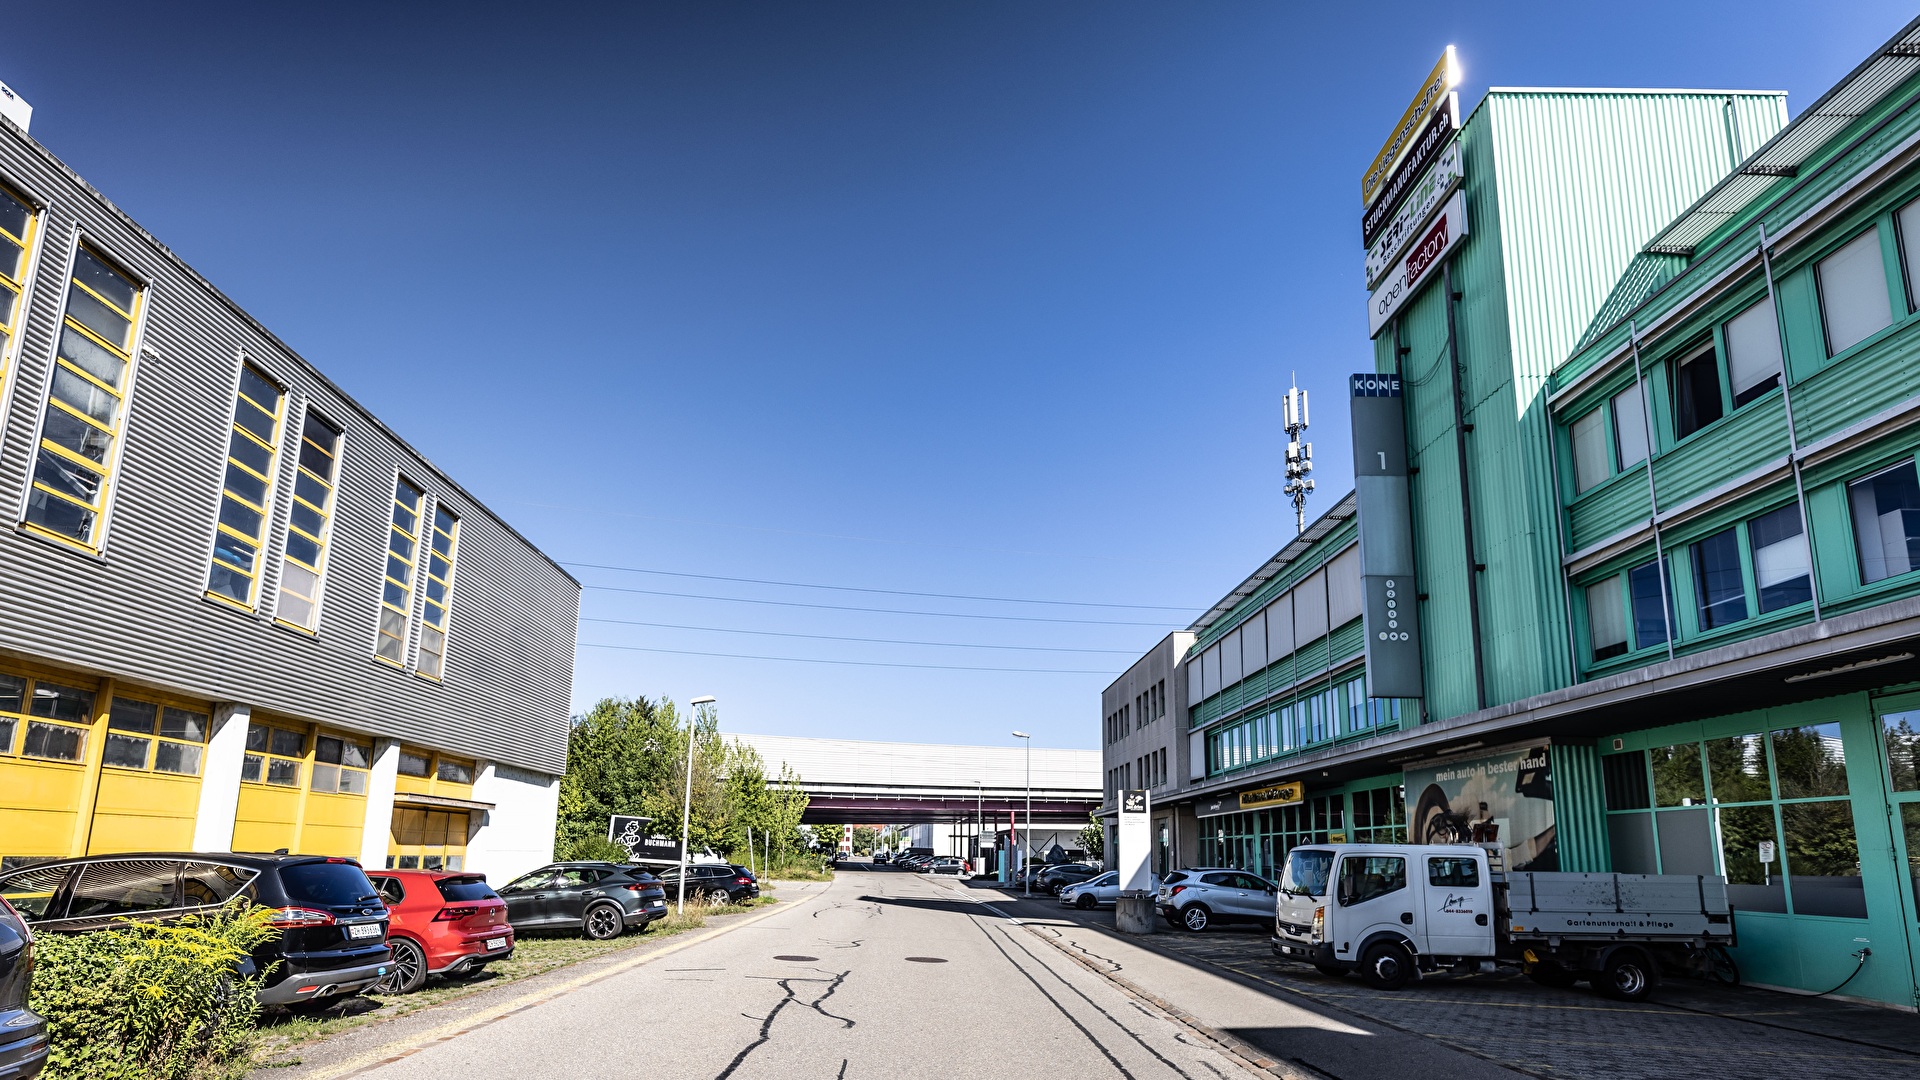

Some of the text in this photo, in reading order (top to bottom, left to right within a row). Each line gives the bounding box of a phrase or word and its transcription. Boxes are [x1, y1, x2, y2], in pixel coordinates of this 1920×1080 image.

[1364, 112, 1449, 236] STUCKMANUFAKTUR.ch
[1364, 172, 1379, 194] Die
[1382, 195, 1436, 265] Beschriftungen
[1354, 380, 1400, 391] KONE
[1377, 451, 1386, 470] 1
[1435, 753, 1547, 782] mein auto in bester hand
[645, 839, 676, 848] BUCHMANN
[1566, 919, 1637, 927] Gartenunterhalt
[1646, 920, 1674, 929] Pflege
